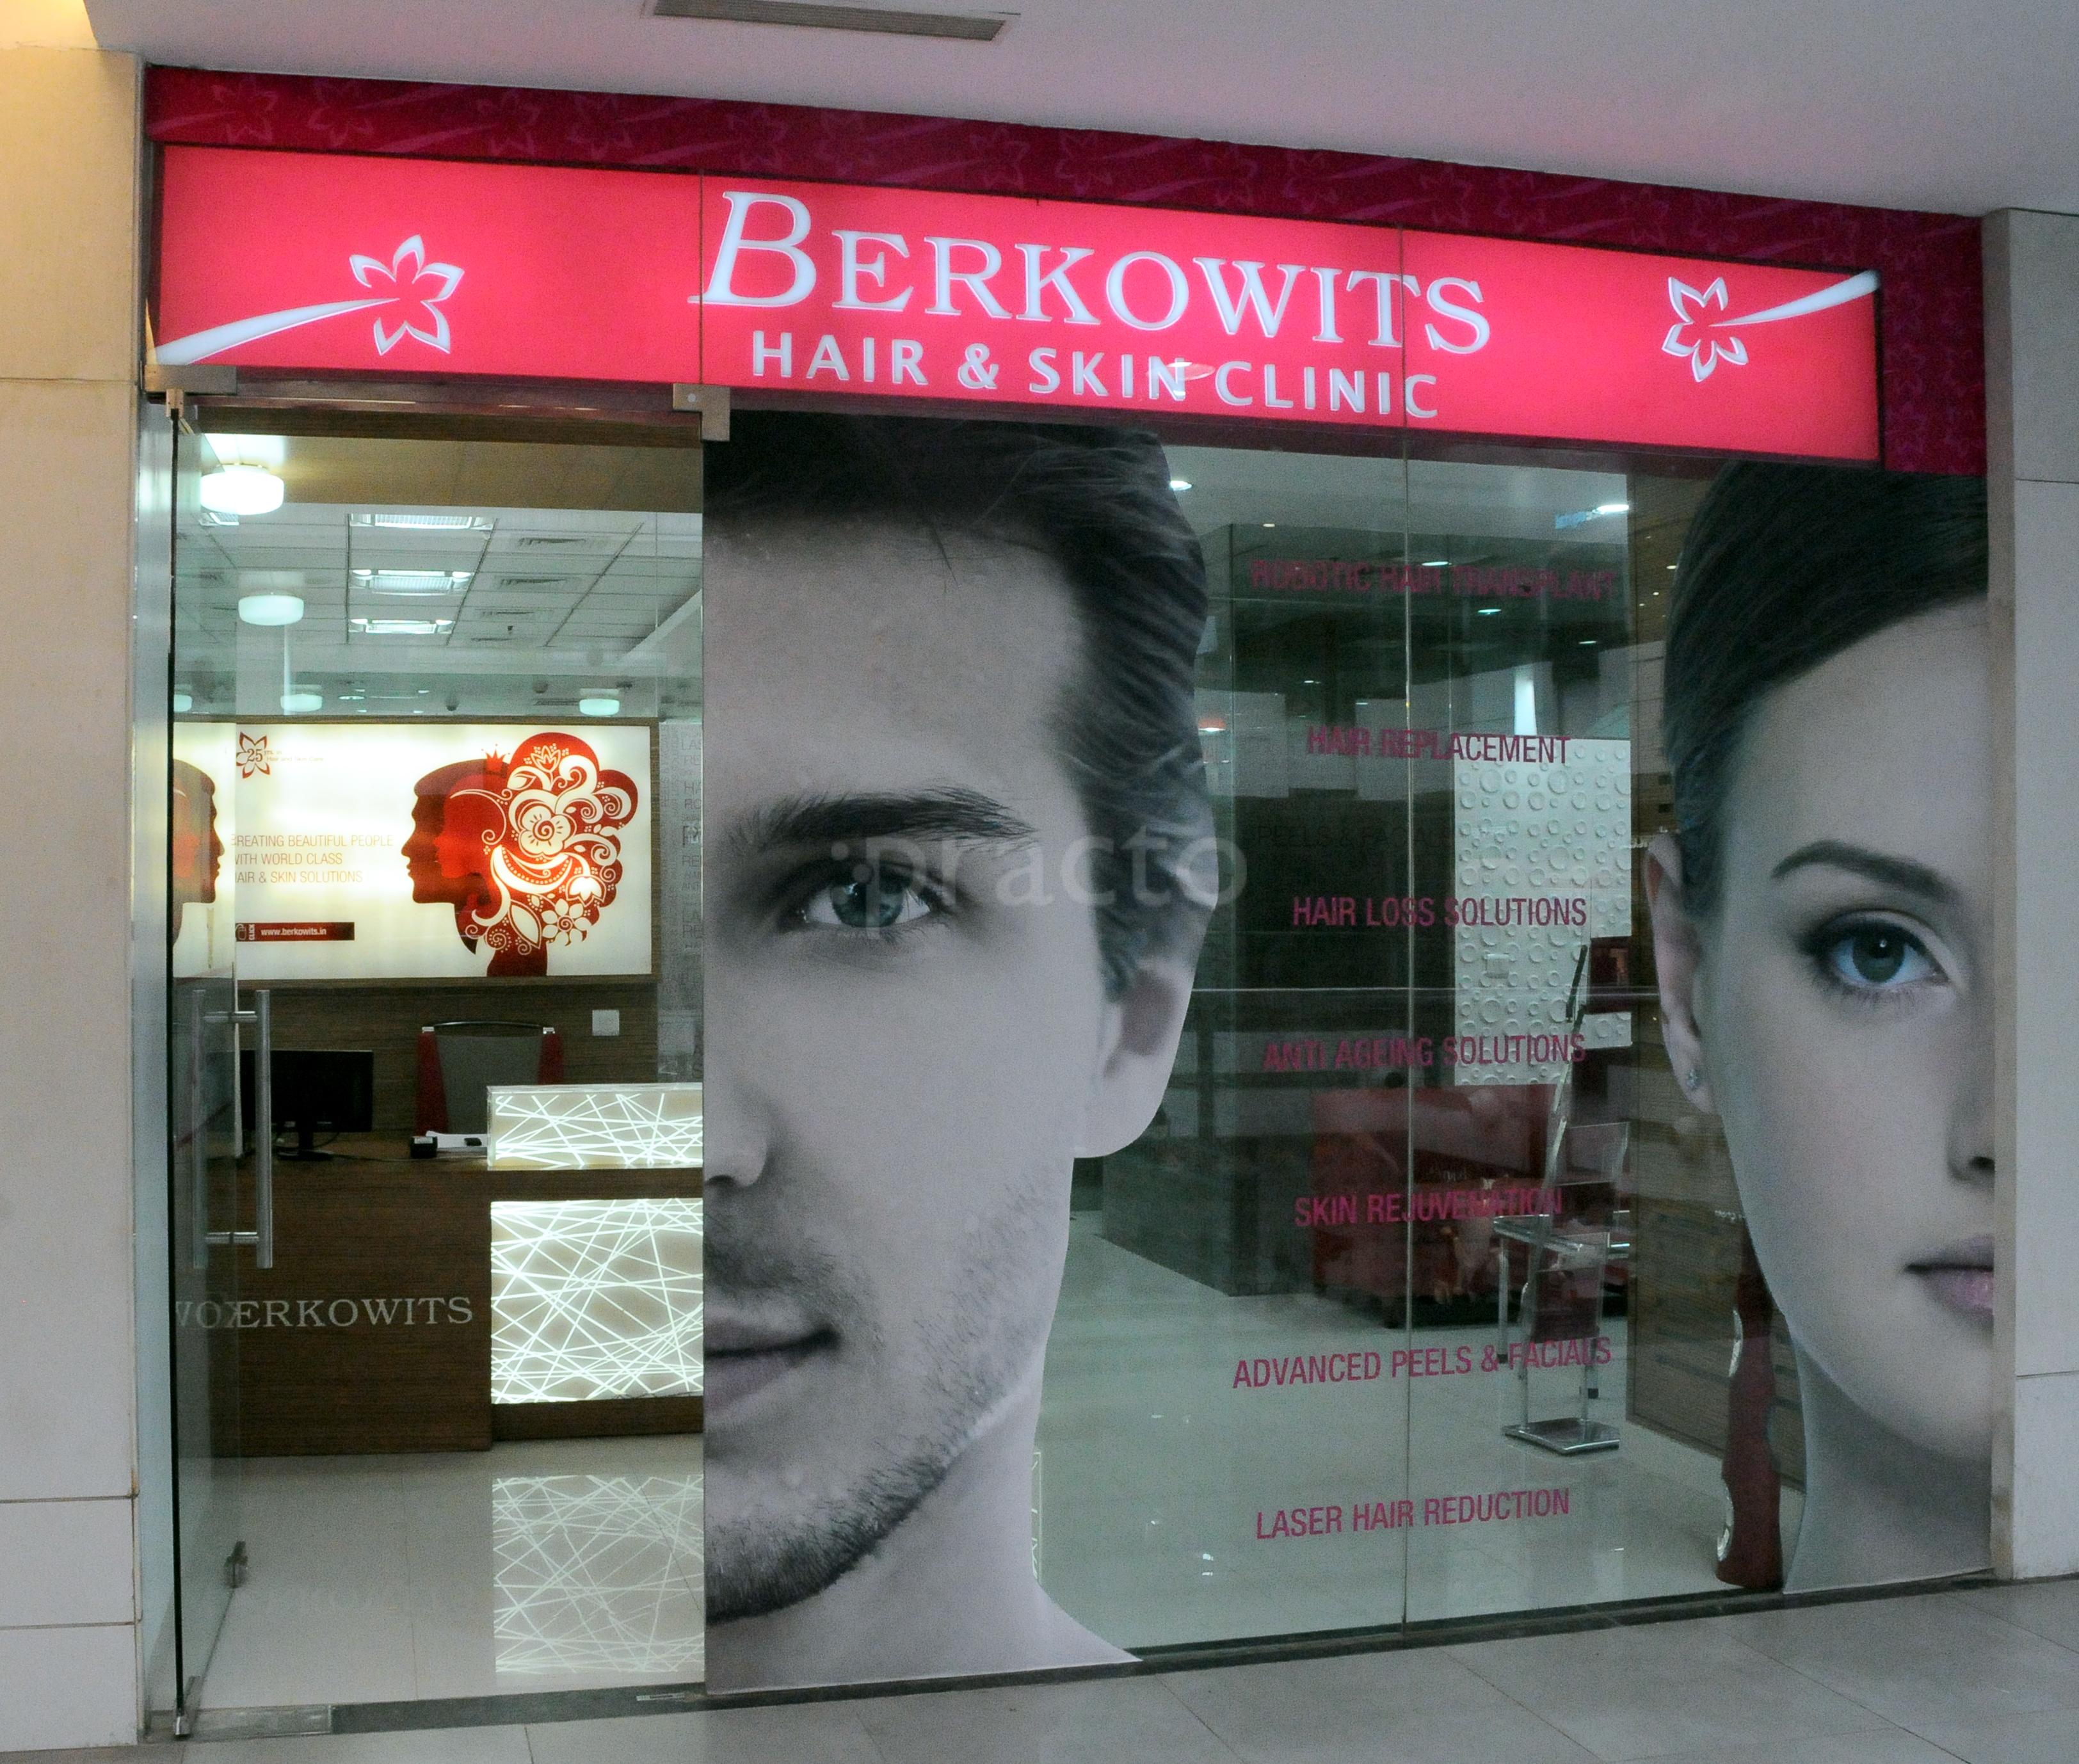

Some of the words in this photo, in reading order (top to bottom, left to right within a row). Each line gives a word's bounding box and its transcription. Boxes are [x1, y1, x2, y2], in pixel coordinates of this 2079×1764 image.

[687, 190, 1490, 355] BERKOWITS
[752, 330, 928, 385] HAIR
[958, 342, 999, 390] &
[1029, 348, 1186, 401] SKIN
[1215, 360, 1438, 419] CLINIC
[247, 748, 263, 762] 25
[1306, 725, 1371, 756] HAIR
[1381, 729, 1571, 764] REPLACEMENT
[287, 835, 347, 847] BEAUTIFUL
[351, 835, 394, 847] PEOPLE
[235, 871, 255, 883] AIR
[258, 871, 267, 883] &
[270, 870, 296, 883] SKIN
[300, 870, 363, 883] SOLUTIONS
[261, 853, 303, 865] WORLD
[307, 853, 342, 865] CLASS
[1292, 896, 1356, 927] HAIR
[1366, 897, 1435, 927] LOSS
[1444, 897, 1587, 927] SOLUTIONS
[261, 927, 327, 936] www.berkowits.in
[1262, 1039, 1326, 1071] ANTI
[1334, 1037, 1433, 1070] AGEING
[1443, 1032, 1586, 1065] SOLUTIONS
[1294, 1196, 1358, 1227] SKIN
[1366, 1187, 1563, 1225] REJUVENATION
[236, 1296, 474, 1328] ERKOWITS
[1232, 1351, 1381, 1389] ADVANCED
[1391, 1345, 1472, 1379] PEELS
[1481, 1343, 1500, 1373] &
[1508, 1336, 1612, 1370] FACIALS
[1255, 1505, 1343, 1541] LASER
[1352, 1498, 1415, 1532] HAIR
[1424, 1487, 1569, 1527] REDUCTION
